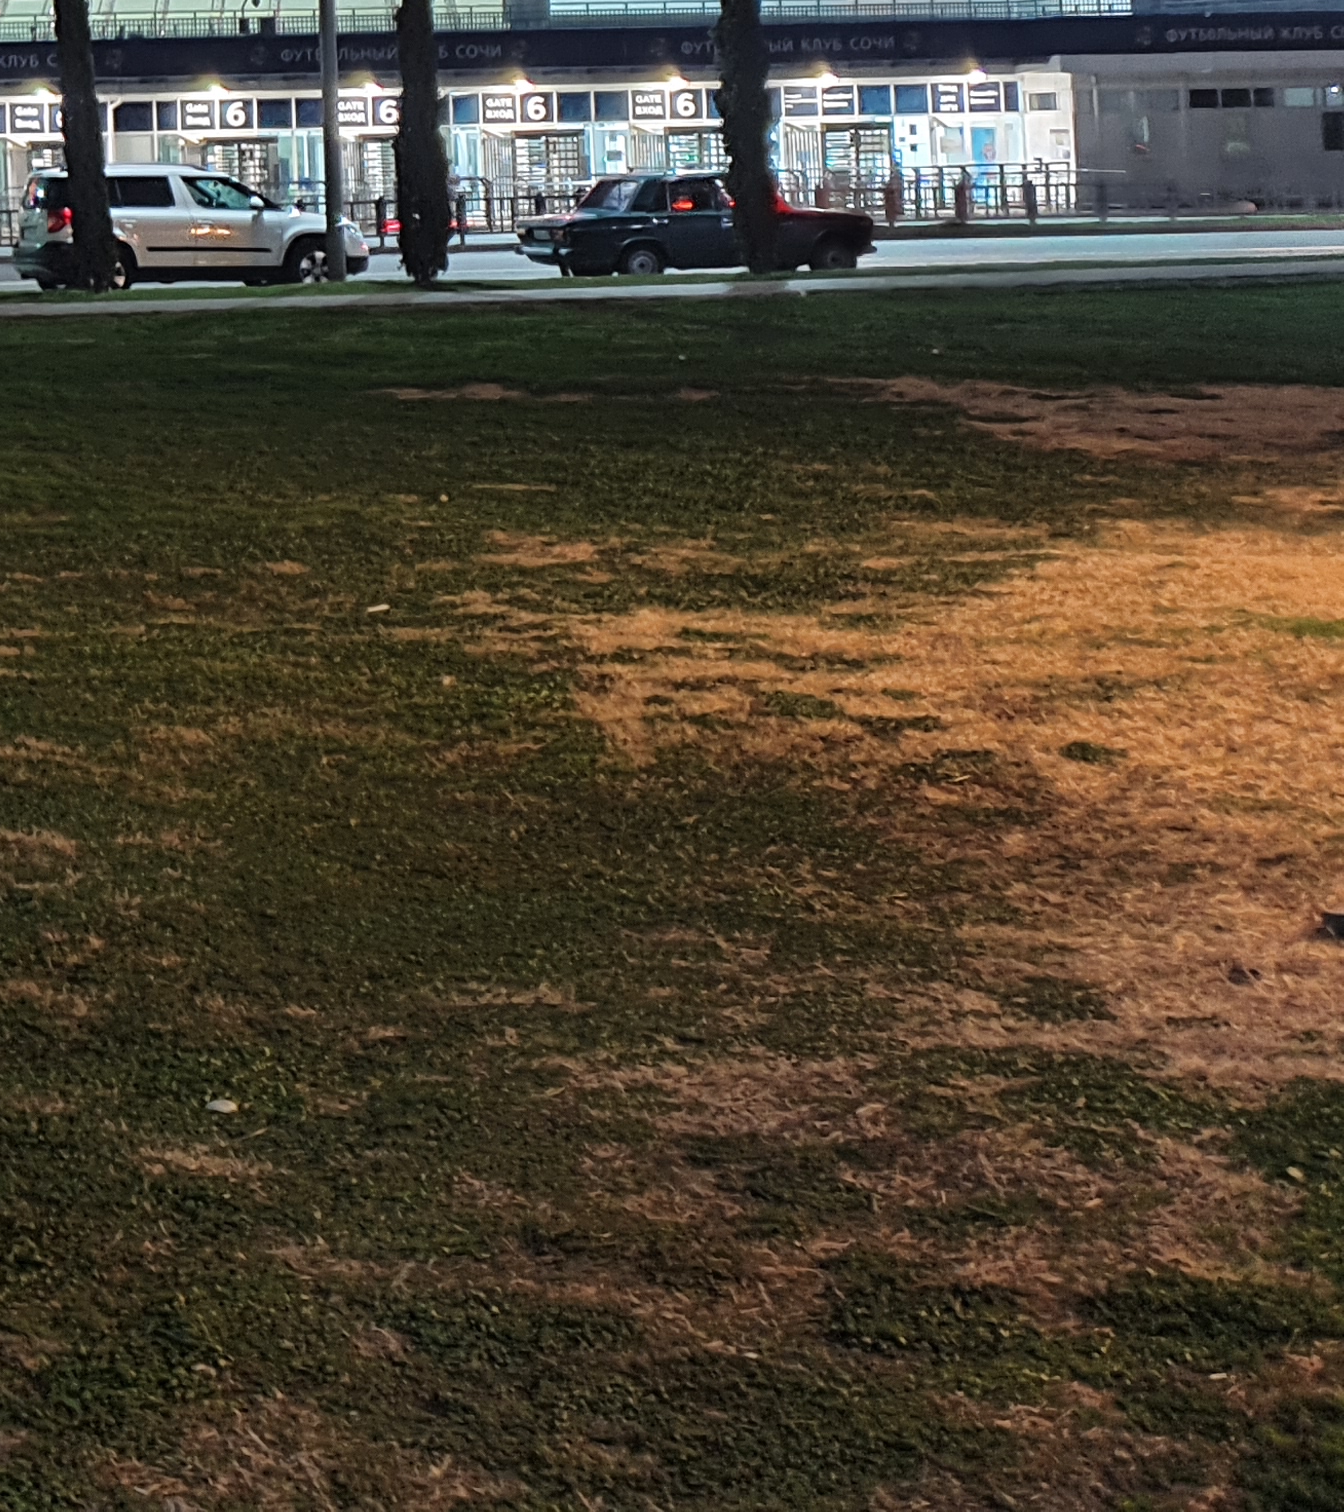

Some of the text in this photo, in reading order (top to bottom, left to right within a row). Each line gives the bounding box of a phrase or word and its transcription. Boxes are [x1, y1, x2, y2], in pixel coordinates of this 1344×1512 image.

[280, 45, 399, 63] ФУТБЛЬНЫЙ
[455, 44, 503, 60] СОЧИ
[800, 37, 843, 52] КЛУБ
[849, 35, 895, 51] СОЧИ
[226, 101, 246, 127] 6
[379, 99, 400, 124] 6
[527, 96, 546, 121] 6
[677, 92, 696, 117] 6
